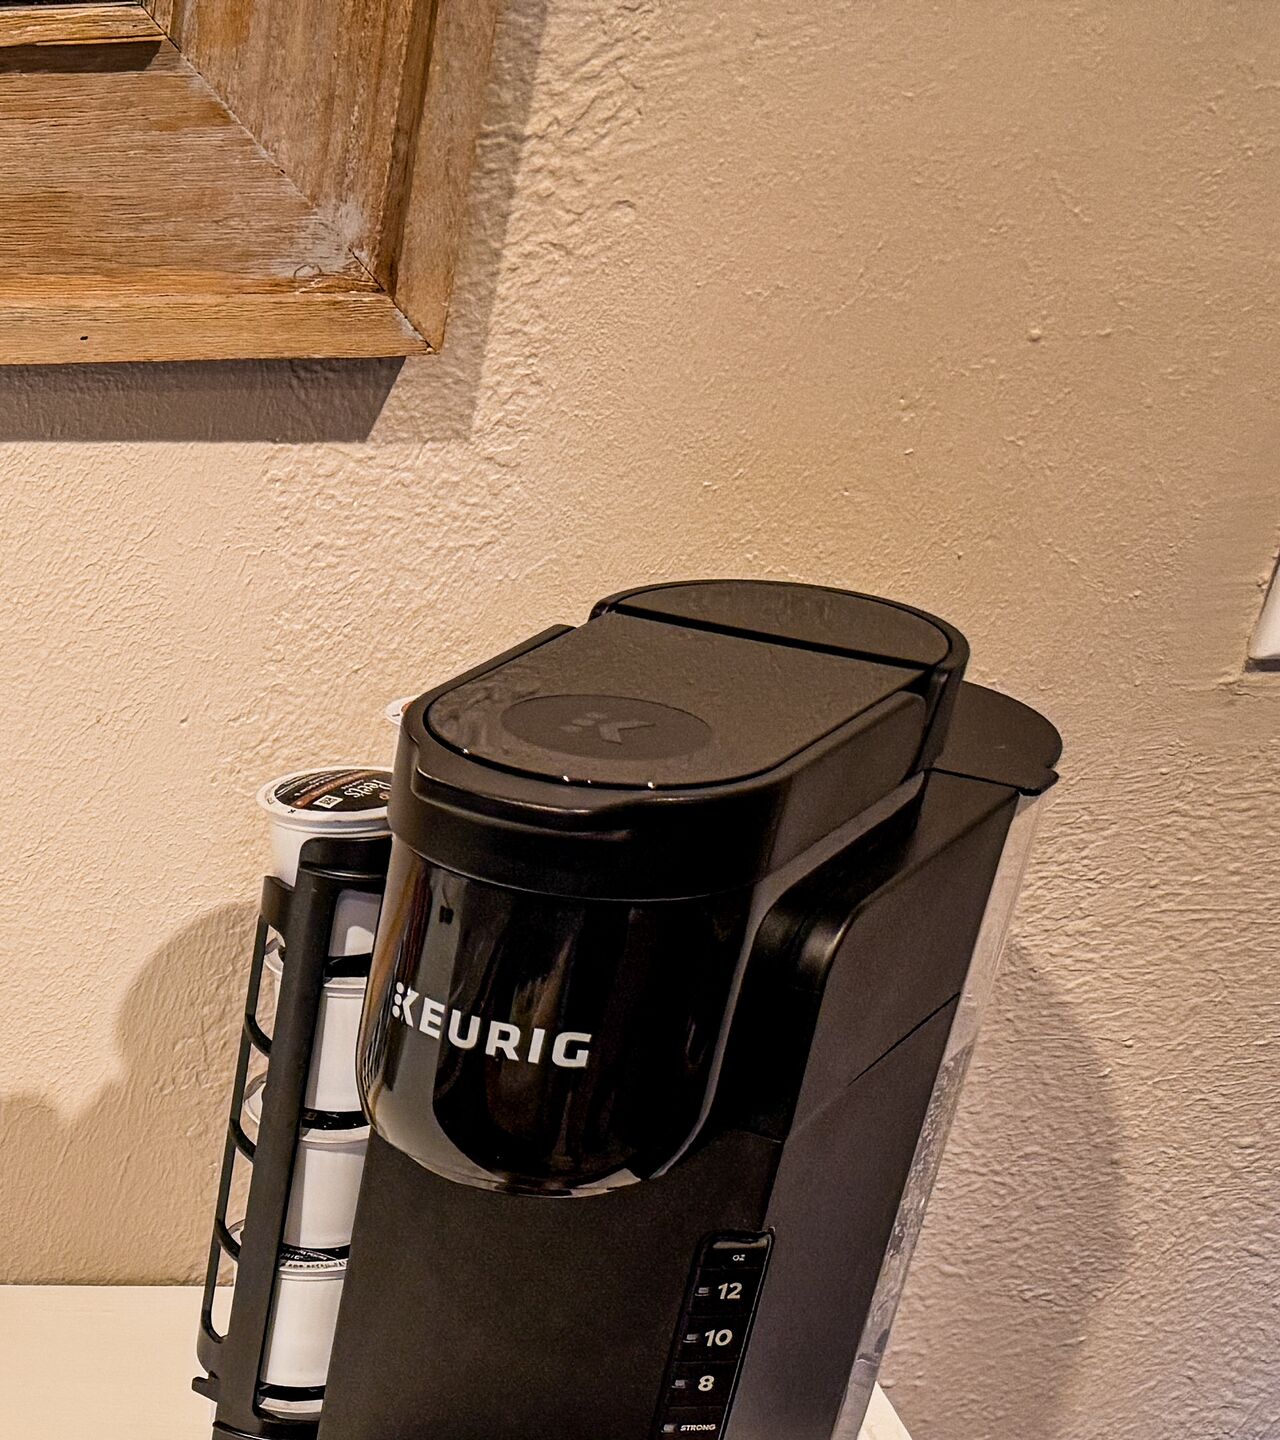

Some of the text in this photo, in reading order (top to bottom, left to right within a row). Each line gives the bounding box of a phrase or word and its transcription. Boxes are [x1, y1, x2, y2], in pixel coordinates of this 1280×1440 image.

[392, 981, 592, 1068] KEURIG
[718, 1282, 743, 1300] 12
[704, 1329, 733, 1347] 10
[698, 1375, 715, 1391] 8
